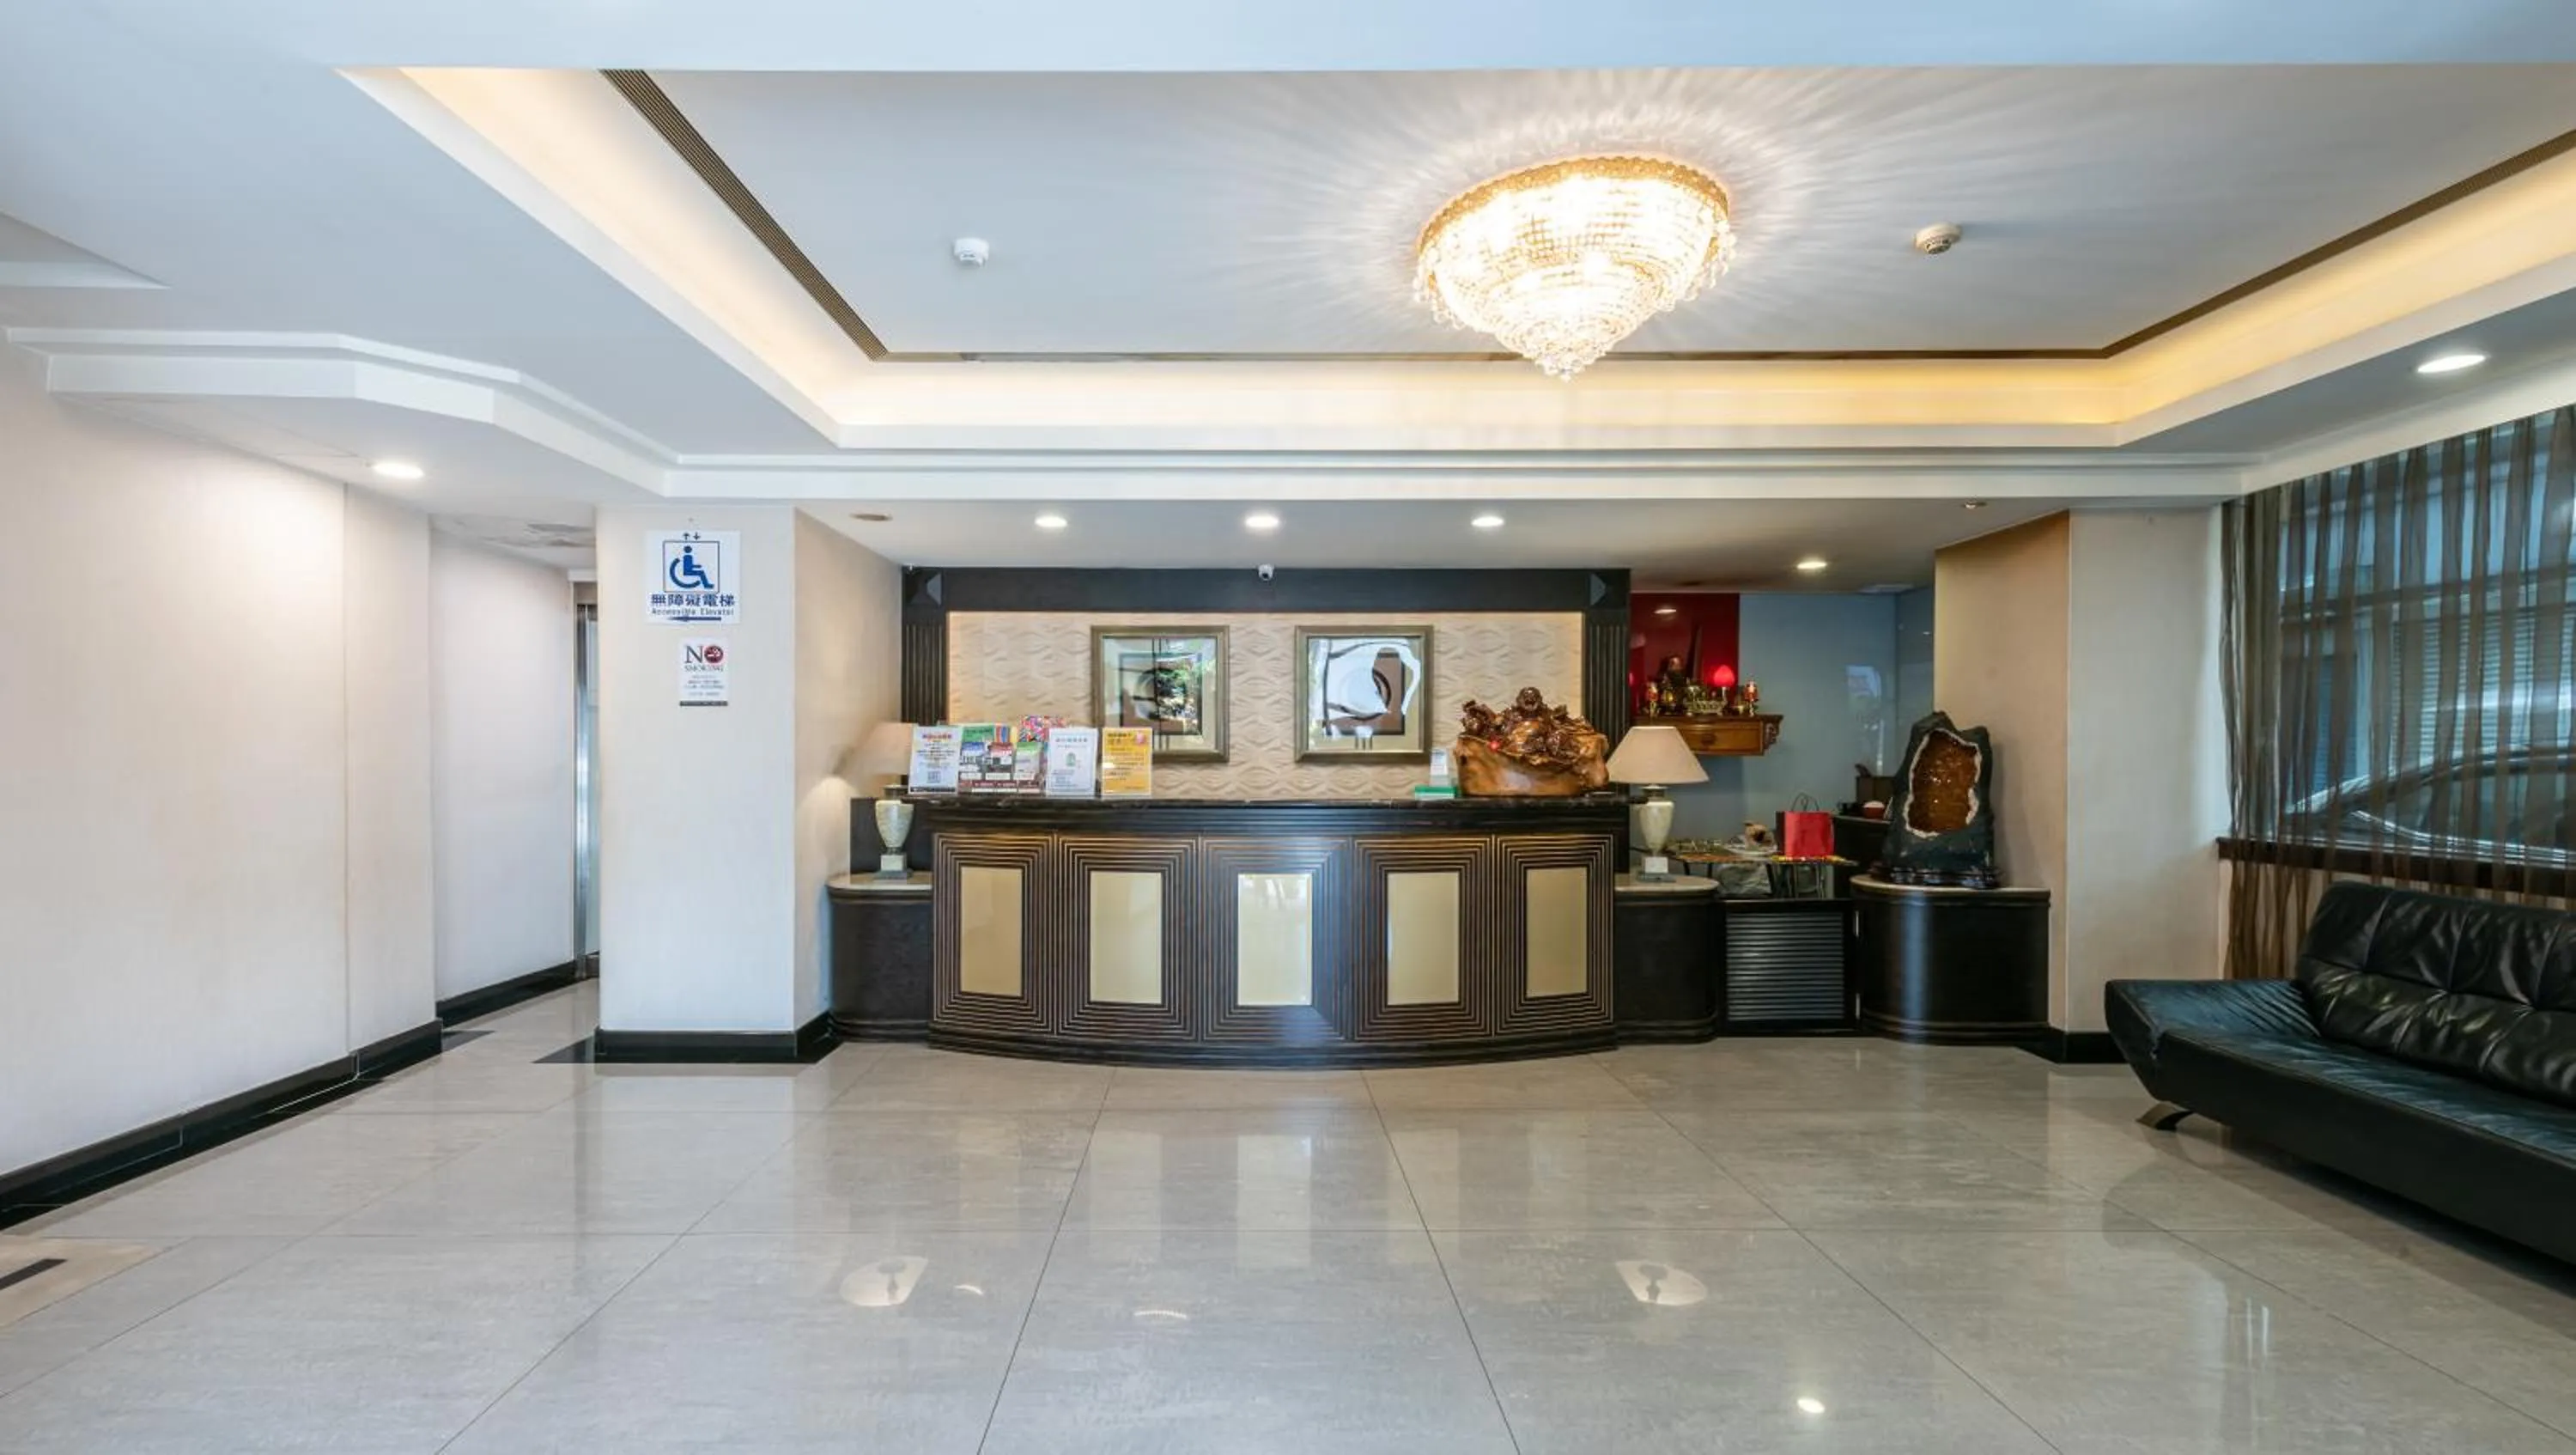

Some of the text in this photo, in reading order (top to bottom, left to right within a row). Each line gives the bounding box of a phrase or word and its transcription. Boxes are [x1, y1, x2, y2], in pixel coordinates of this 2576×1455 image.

[651, 594, 734, 606] 無障礙電梯
